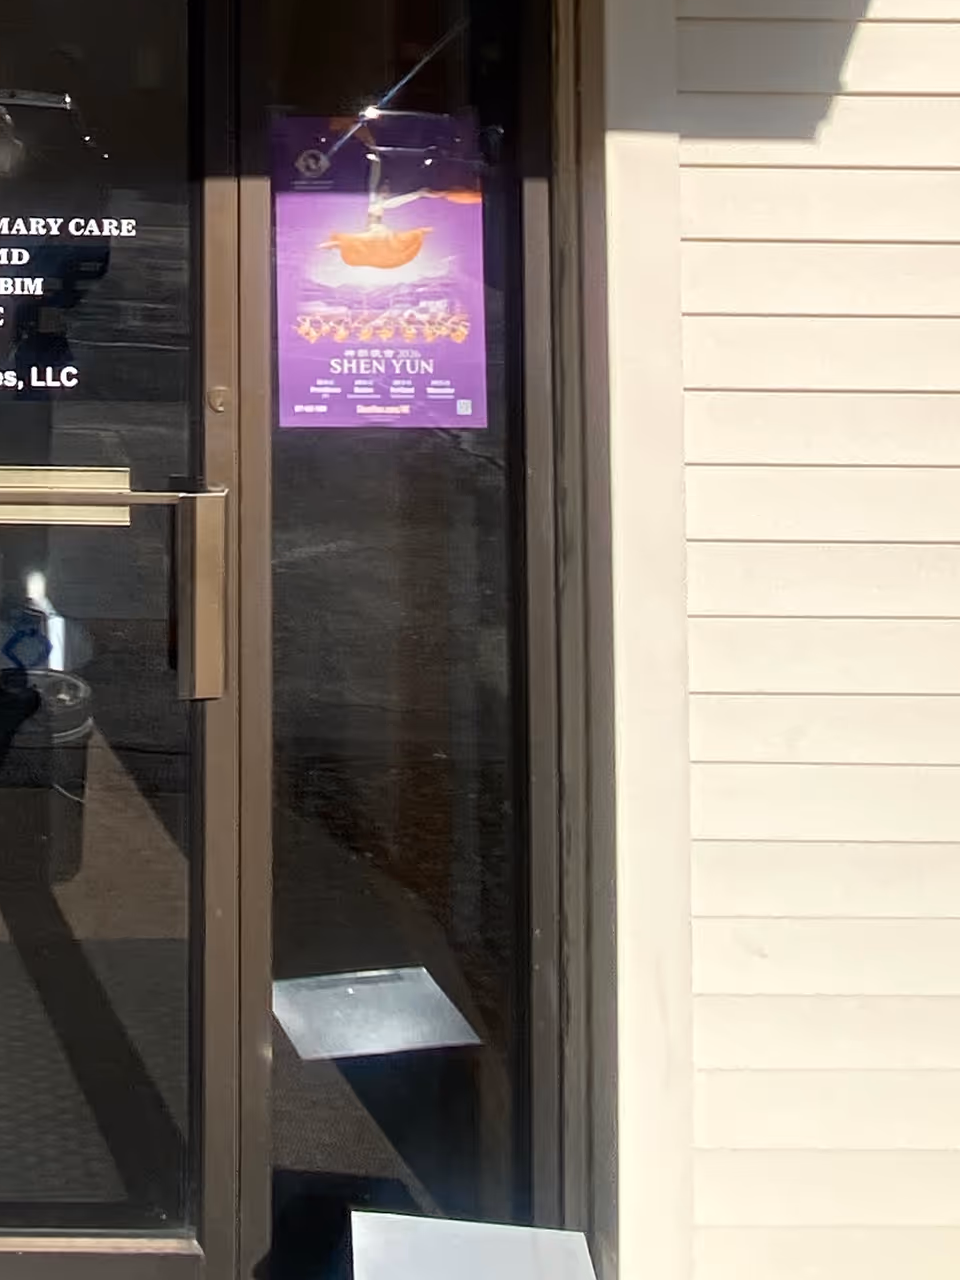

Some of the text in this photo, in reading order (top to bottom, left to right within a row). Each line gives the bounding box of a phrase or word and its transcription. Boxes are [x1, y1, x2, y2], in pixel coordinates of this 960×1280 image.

[68, 218, 137, 237] CARE
[329, 358, 434, 375] SHEN YUN
[30, 366, 79, 388] LLC
